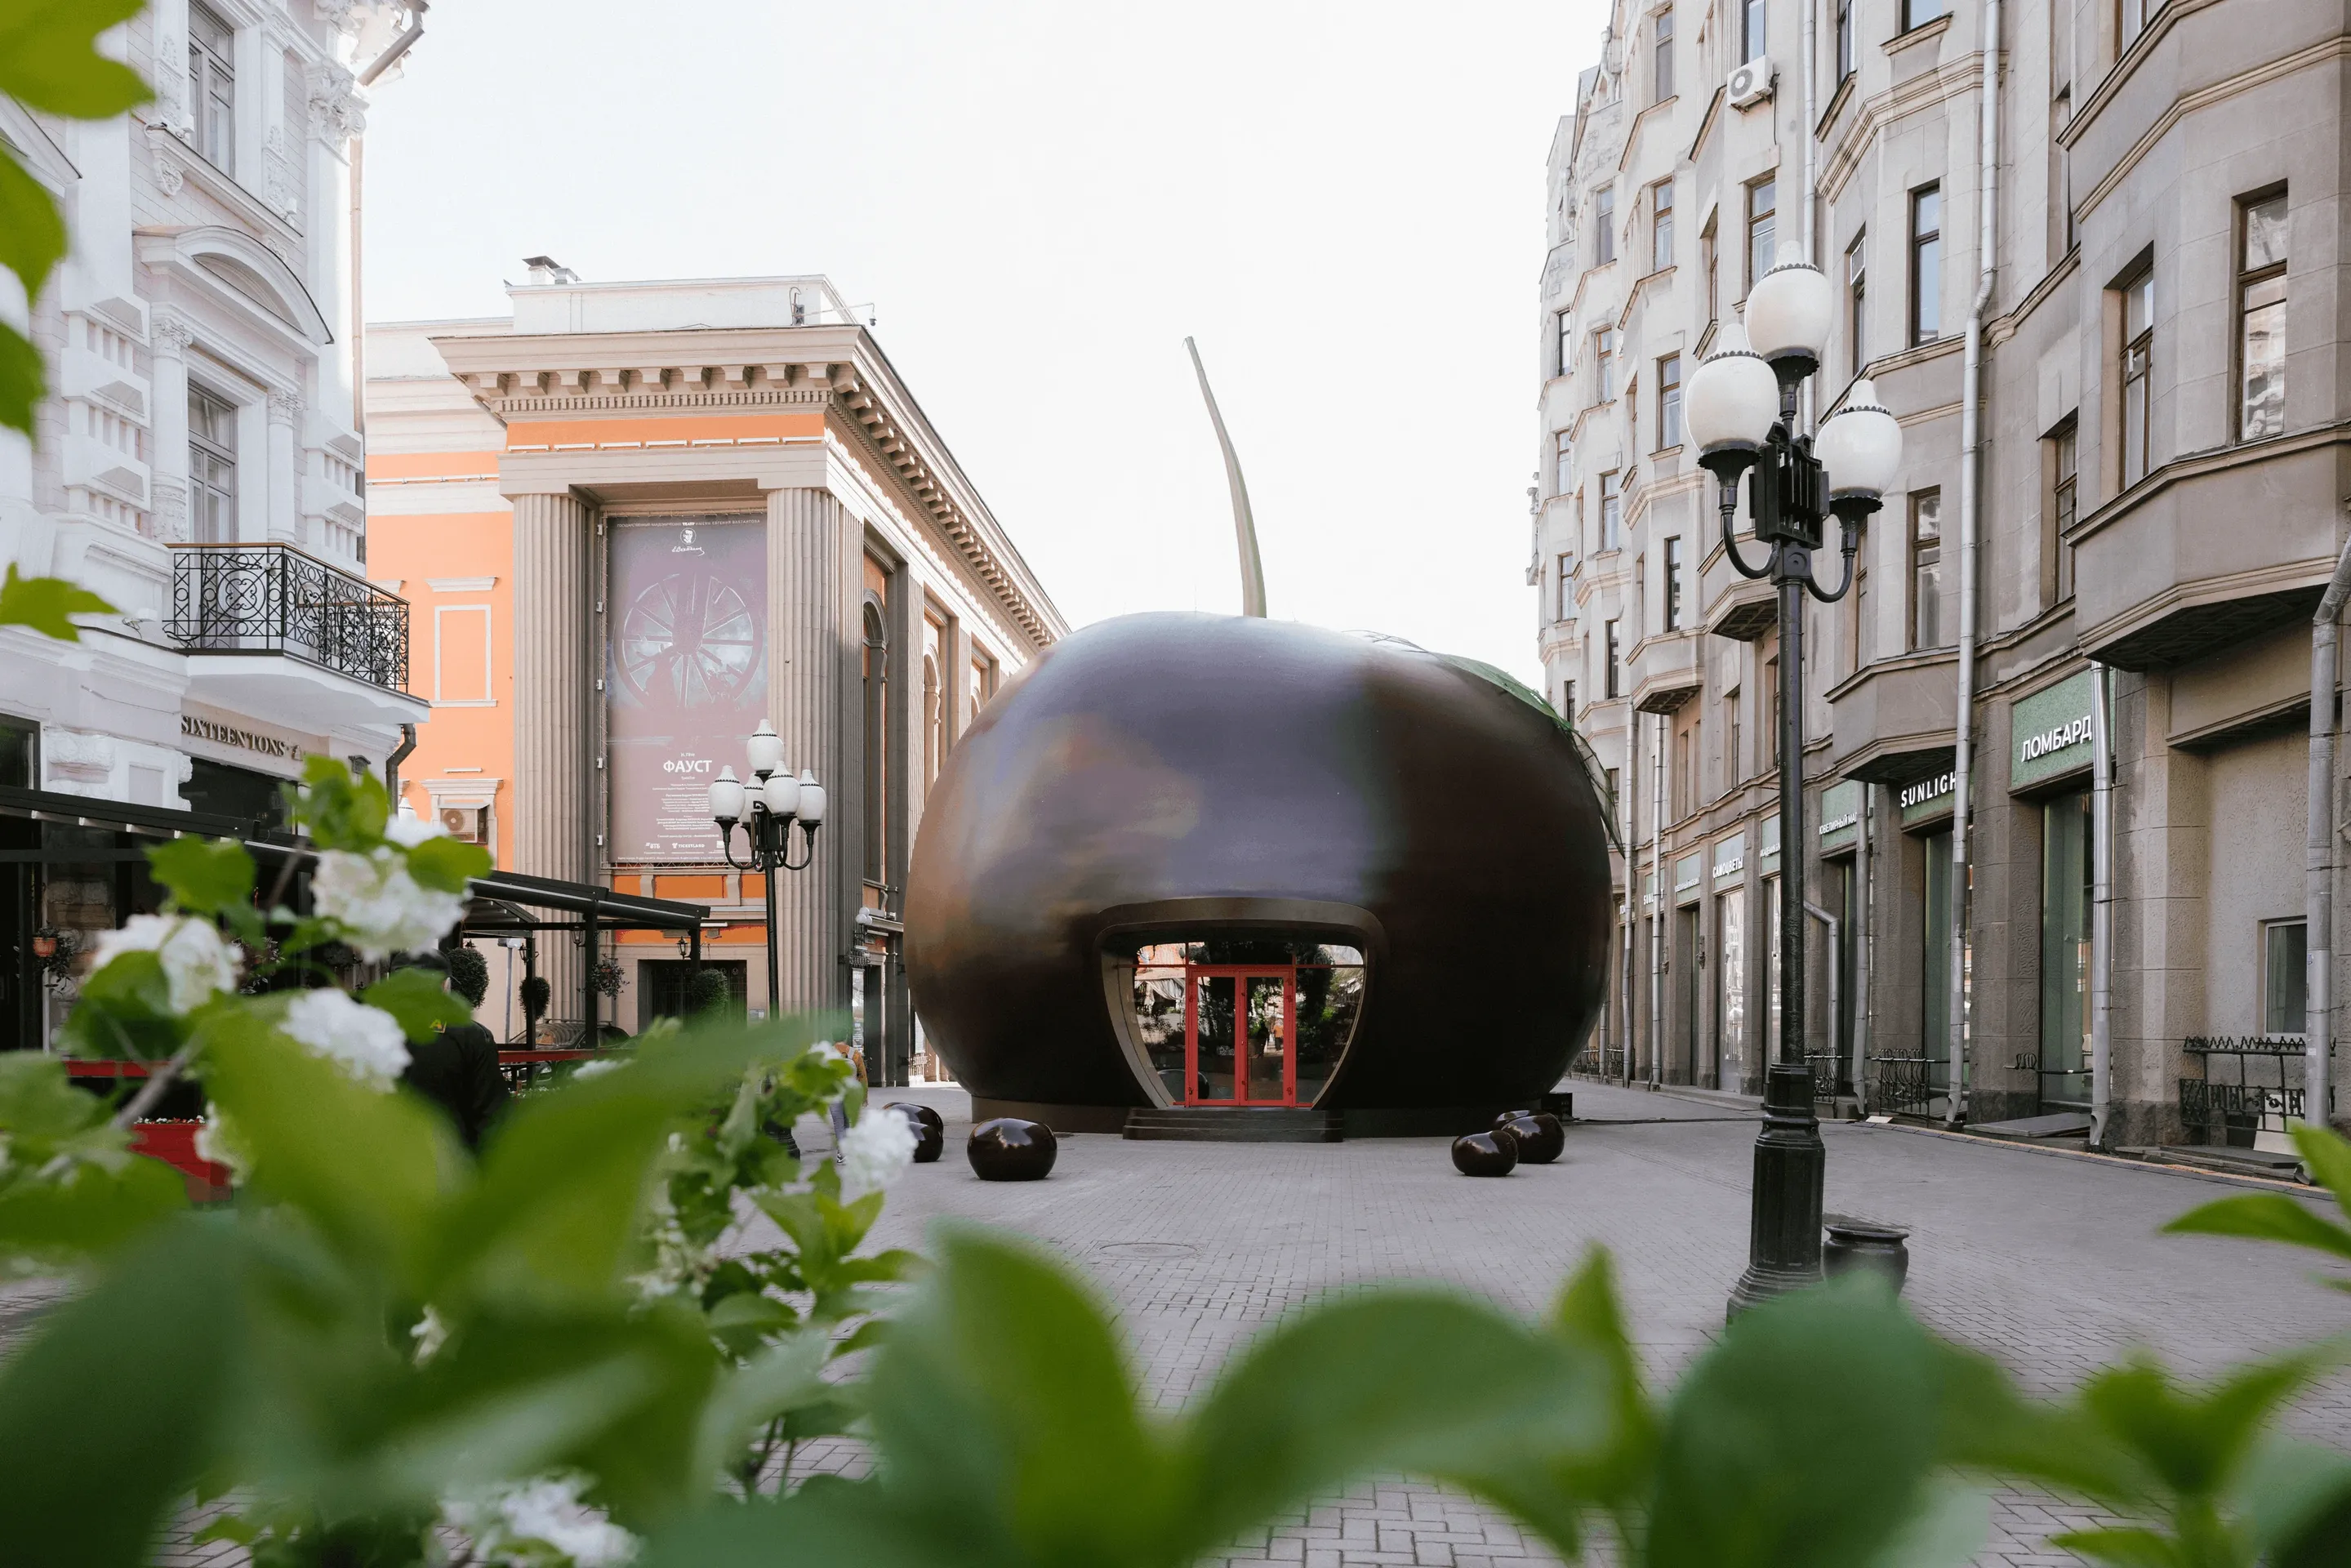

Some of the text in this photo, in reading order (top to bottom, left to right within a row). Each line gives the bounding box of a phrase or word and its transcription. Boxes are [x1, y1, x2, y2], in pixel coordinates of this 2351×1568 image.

[181, 715, 286, 756] SIXTEEN TONS
[2021, 715, 2092, 763] ЛОМБАРД
[663, 760, 713, 773] ФАУСТ
[1901, 770, 1957, 808] SUNLIGH
[1819, 813, 1848, 835] ЮВЕЛИРНЫЙ
